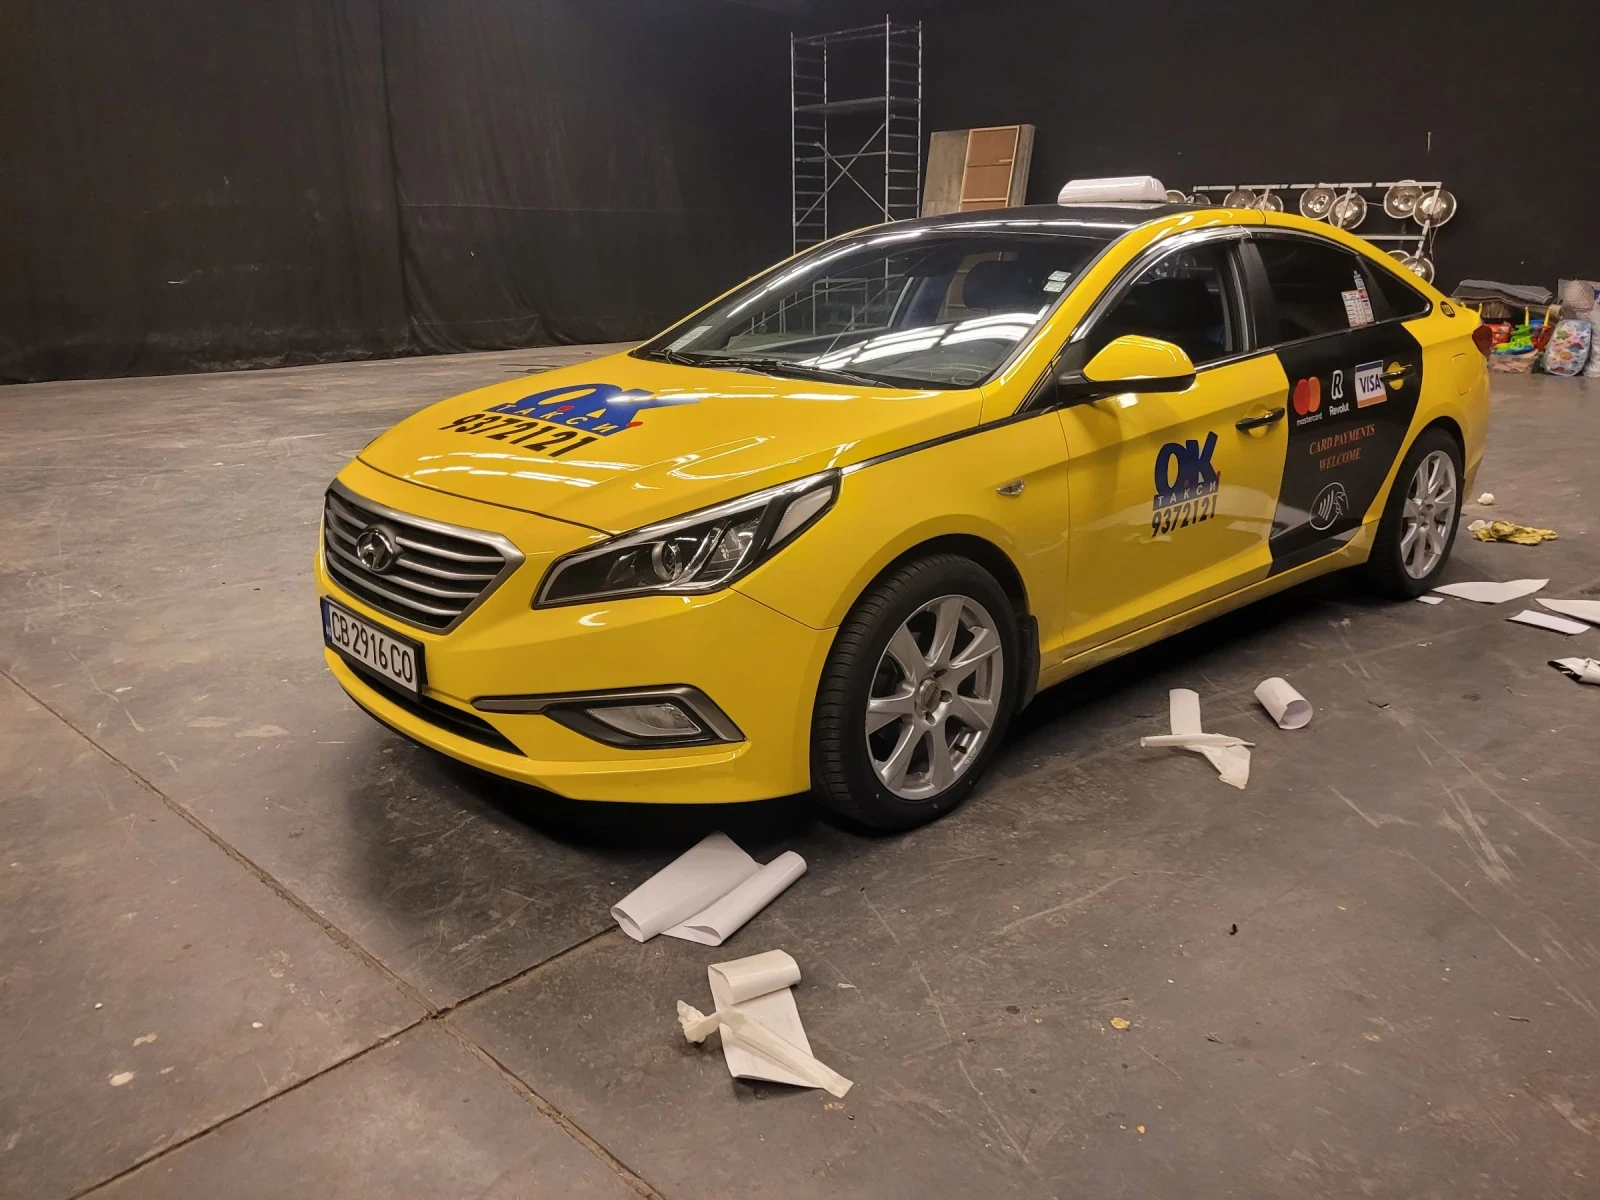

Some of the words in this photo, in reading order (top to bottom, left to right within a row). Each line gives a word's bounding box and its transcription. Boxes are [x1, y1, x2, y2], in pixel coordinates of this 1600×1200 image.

[1359, 373, 1382, 394] VISA
[1296, 411, 1323, 426] mastercard
[1329, 401, 1350, 417] Revolut
[438, 413, 599, 458] 9372121
[1309, 436, 1333, 455] CARD
[1334, 423, 1375, 447] PAYMENTS
[1319, 447, 1362, 471] WELCOME
[1157, 481, 1217, 507] ТАКСИ
[1151, 494, 1218, 538] 9372121
